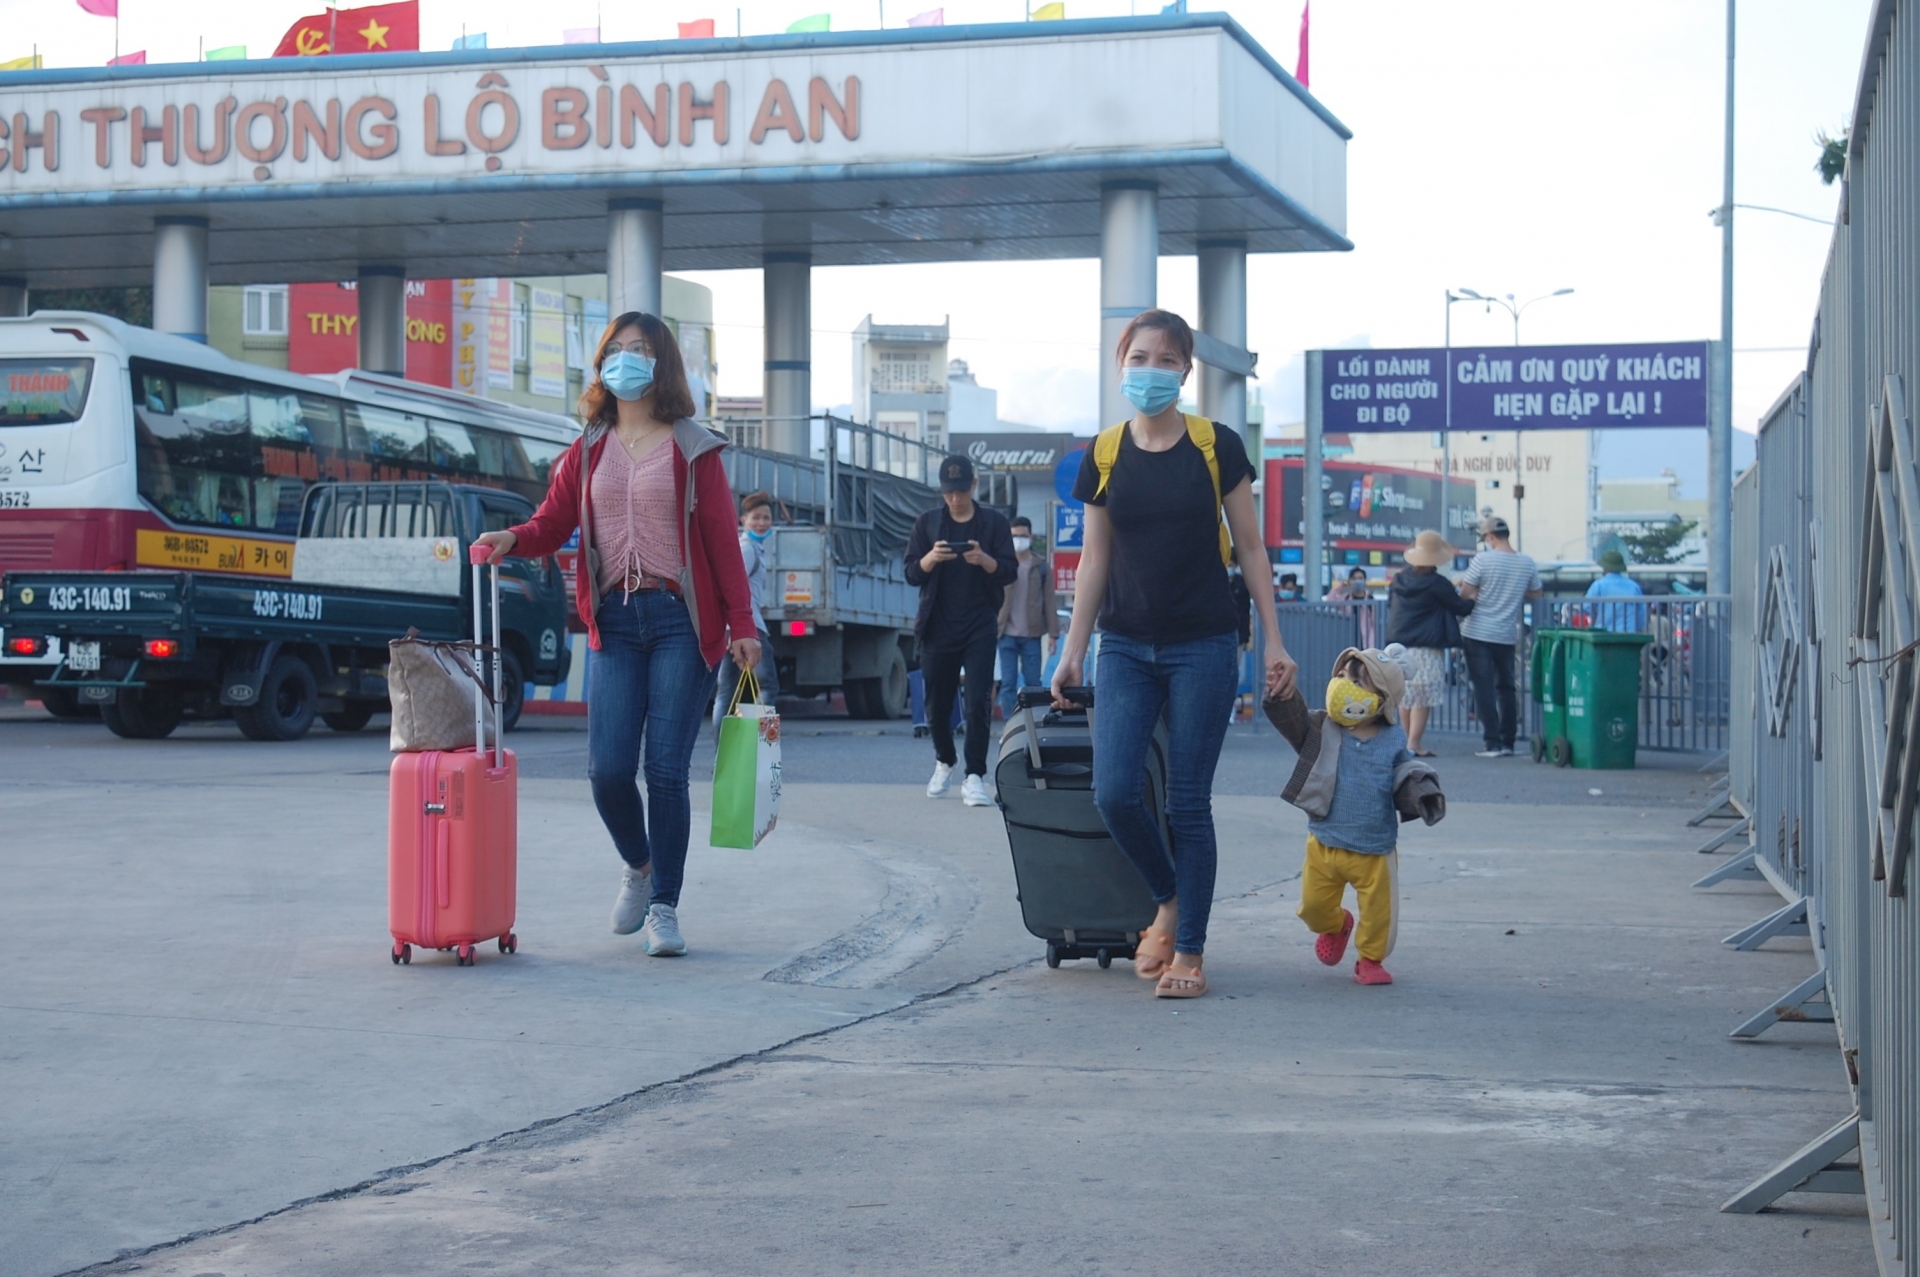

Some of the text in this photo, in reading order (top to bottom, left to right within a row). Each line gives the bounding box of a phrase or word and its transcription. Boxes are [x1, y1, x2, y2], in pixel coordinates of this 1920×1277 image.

[0, 65, 860, 181] H THƯỢNG LỘ BÌNH AN
[307, 313, 446, 344] THY ƠNG
[1338, 355, 1430, 377] LỐI DÀNH
[1457, 353, 1700, 384] CẢM ƠN QUÝ KHÁCH
[1330, 379, 1438, 400] CHO NGƯỜI
[1357, 403, 1410, 426] ĐI BỘ
[1494, 393, 1542, 420] HẸN
[1550, 388, 1599, 420] GẶP
[1607, 391, 1645, 419] LẠI
[19, 448, 46, 473] 산
[1434, 454, 1459, 472] NÀ
[1526, 456, 1551, 472] DUY
[49, 587, 131, 611] 43C-140.91
[253, 590, 322, 620] 43C-140.91
